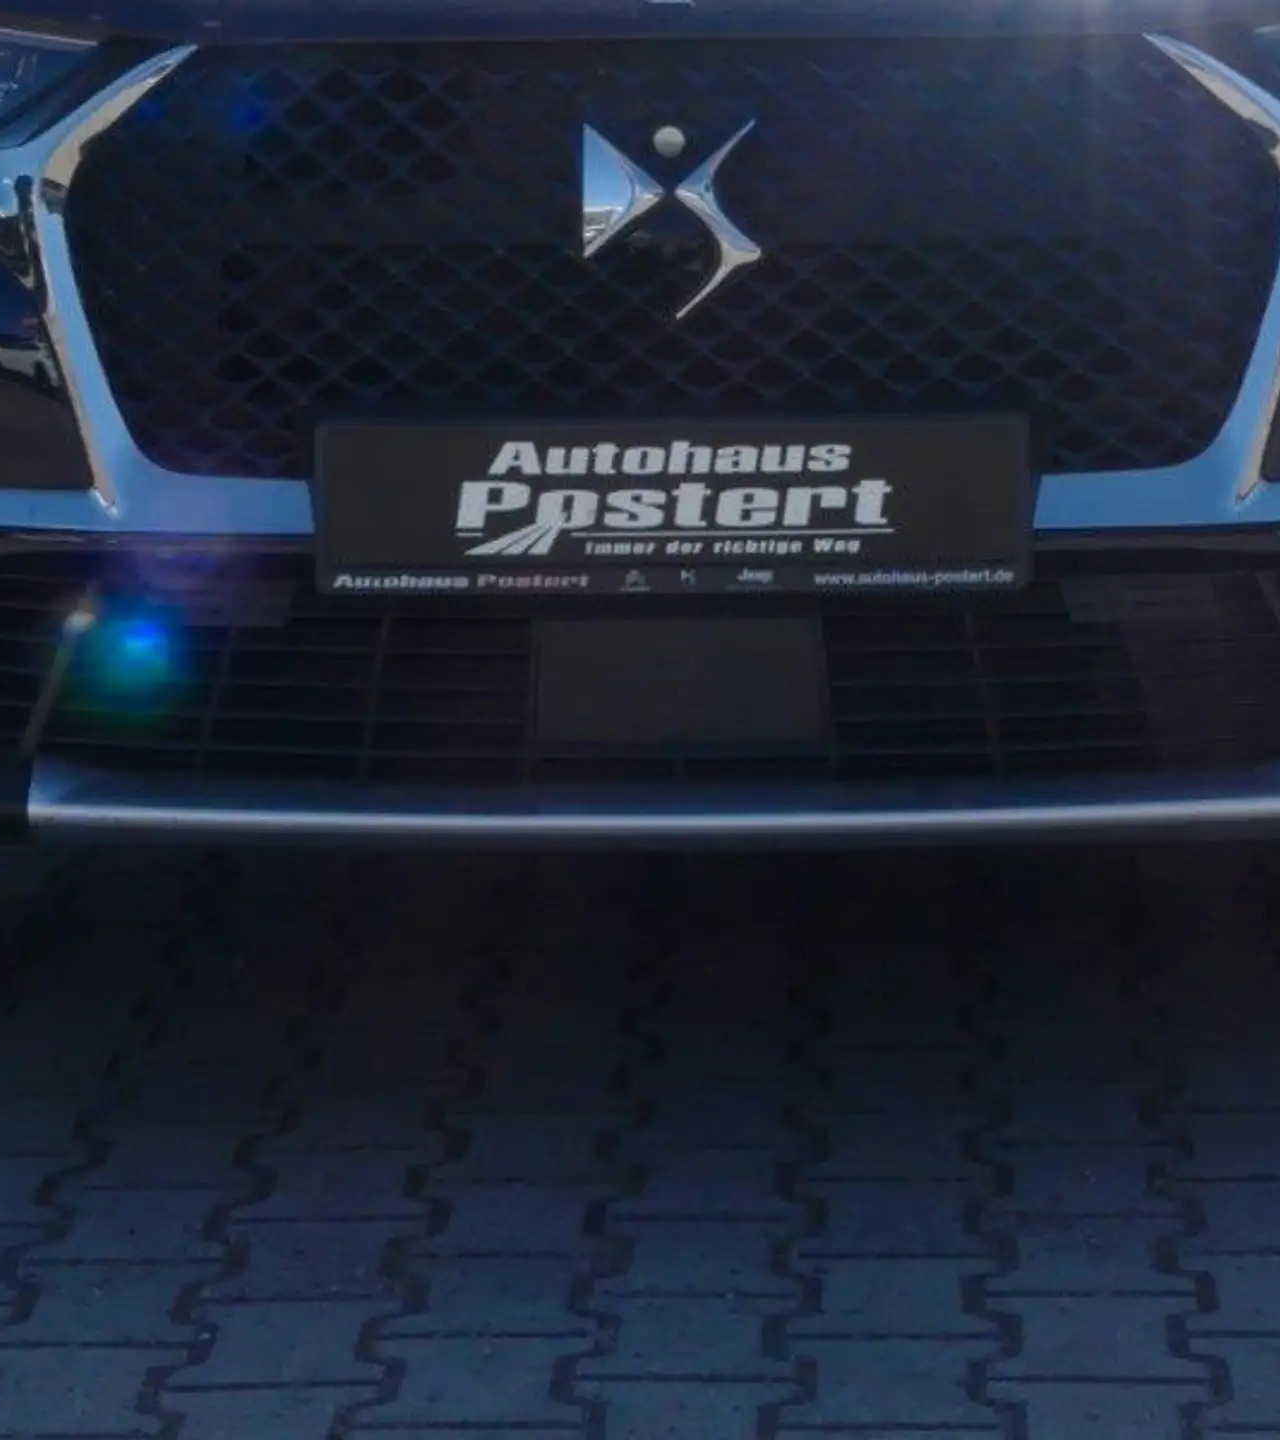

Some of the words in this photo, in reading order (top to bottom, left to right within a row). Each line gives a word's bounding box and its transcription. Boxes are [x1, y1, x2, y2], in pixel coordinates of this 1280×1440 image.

[488, 440, 852, 475] Autohaus
[455, 479, 894, 530] Postert
[665, 539, 704, 555] der
[712, 539, 804, 555] richtige
[813, 537, 861, 554] Weg
[332, 573, 469, 589] Autohaus
[476, 573, 590, 589] Postert
